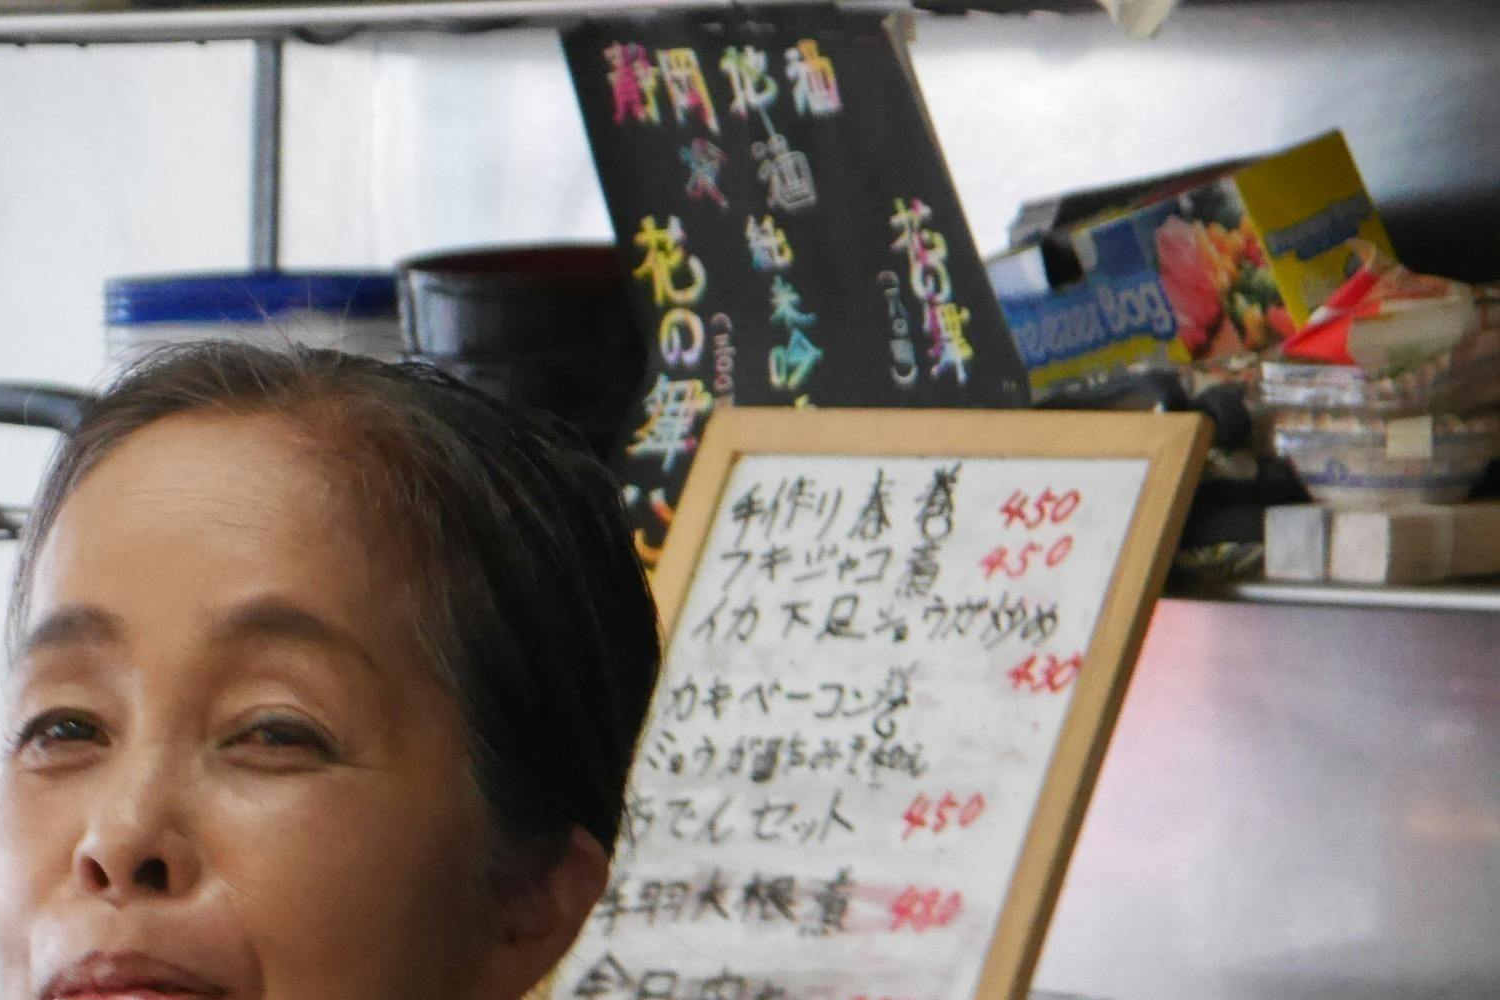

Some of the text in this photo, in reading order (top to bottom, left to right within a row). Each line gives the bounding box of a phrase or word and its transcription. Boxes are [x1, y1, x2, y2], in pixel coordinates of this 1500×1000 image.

[999, 486, 1080, 528] 450
[979, 537, 1074, 580] 450
[901, 793, 986, 840] 450
